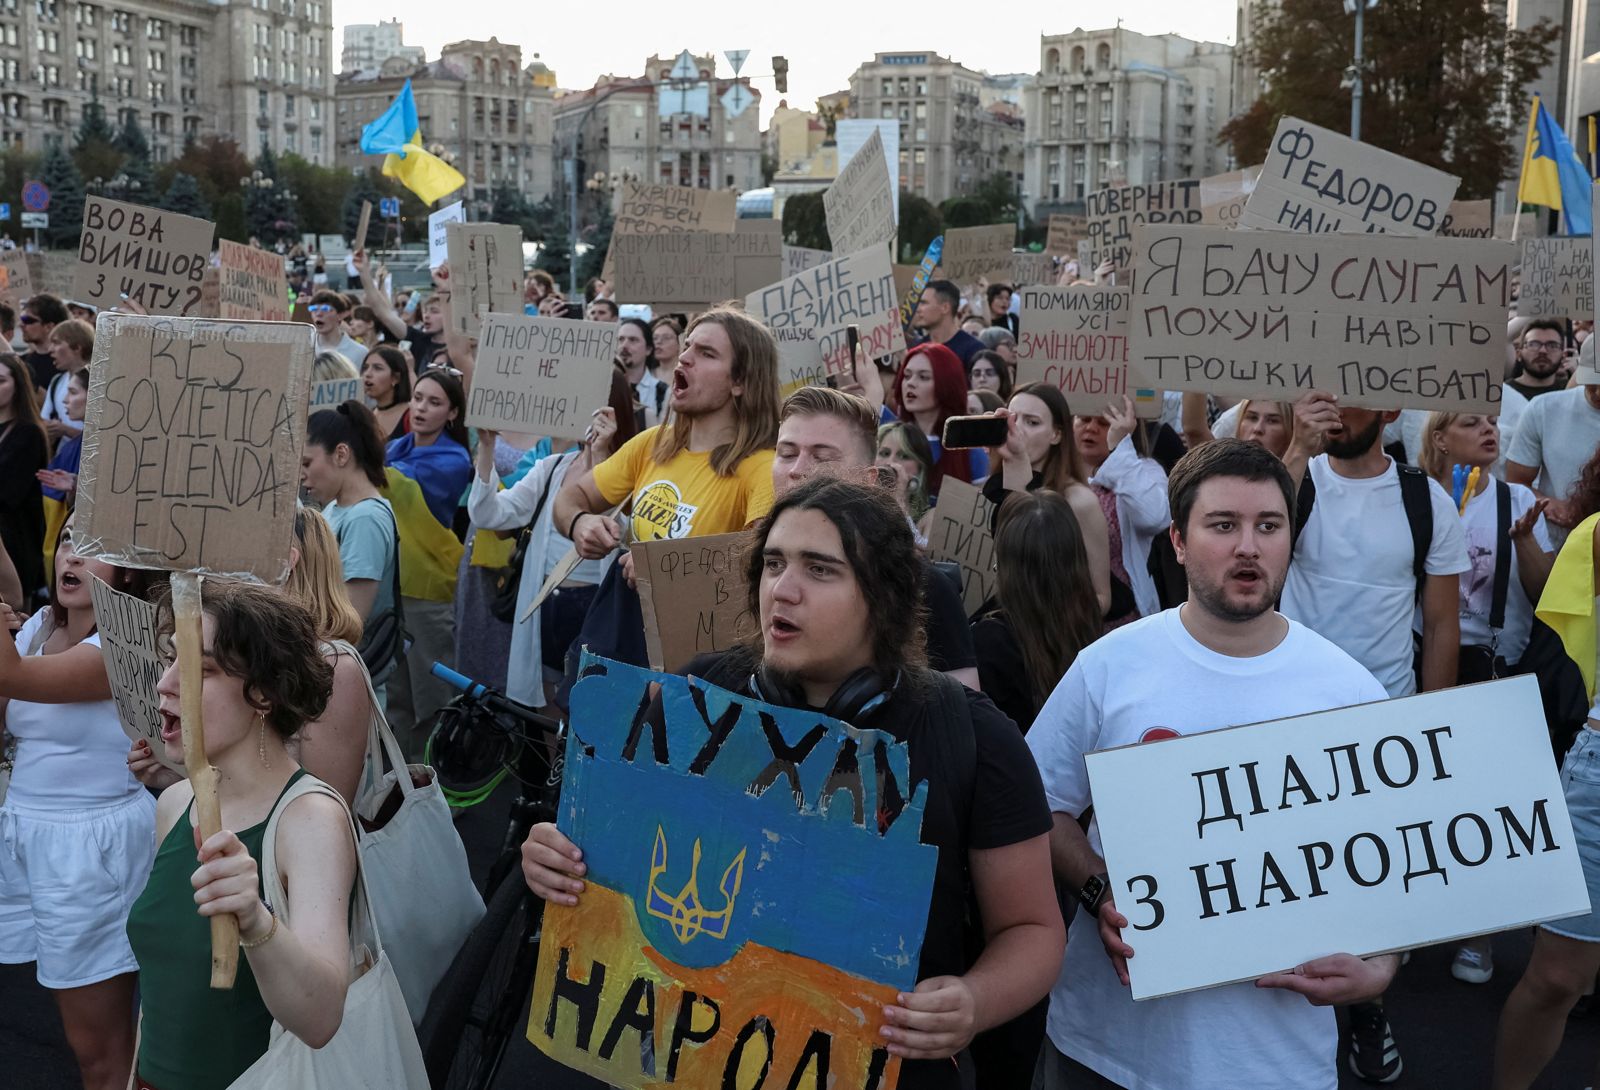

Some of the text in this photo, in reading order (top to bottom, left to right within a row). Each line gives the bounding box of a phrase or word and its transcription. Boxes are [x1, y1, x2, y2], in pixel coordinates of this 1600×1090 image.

[1087, 179, 1200, 217] ПОВЕРНІТ
[1276, 126, 1438, 232] ФЕДОРОВ
[87, 203, 164, 243] ВОВА
[80, 231, 206, 282] ВИЙШОВ
[1141, 235, 1508, 308] Я БАЧУ СЛУГАМ
[89, 273, 105, 298] З
[120, 276, 202, 317] ЧАТУ?
[762, 256, 853, 317] ПАНЕ
[1024, 291, 1130, 312] ПОМИЛЯЮТ
[1575, 297, 1594, 312] ПЕ
[485, 319, 614, 361] ІГНОРУВАННЯ
[1075, 312, 1110, 331] УСІ
[1144, 304, 1290, 343] ПОХУЙ
[1344, 314, 1492, 348] НАВІТЬ
[149, 320, 244, 390] RES
[496, 355, 559, 378] ЦЕ НЕ
[310, 380, 357, 406] ЛУГА
[1043, 364, 1128, 395] СИЛЬНІ
[1144, 354, 1503, 404] ТРОШКИ ПОЄБАТЬ
[99, 376, 297, 452] SOVIETICA
[111, 433, 288, 518] DELENDA
[133, 498, 231, 566] EST
[660, 543, 740, 582] ФЕДОР
[715, 577, 729, 606] В
[1190, 725, 1454, 840] ДІАЛОГ
[1126, 797, 1562, 932] З НАРОДОМ
